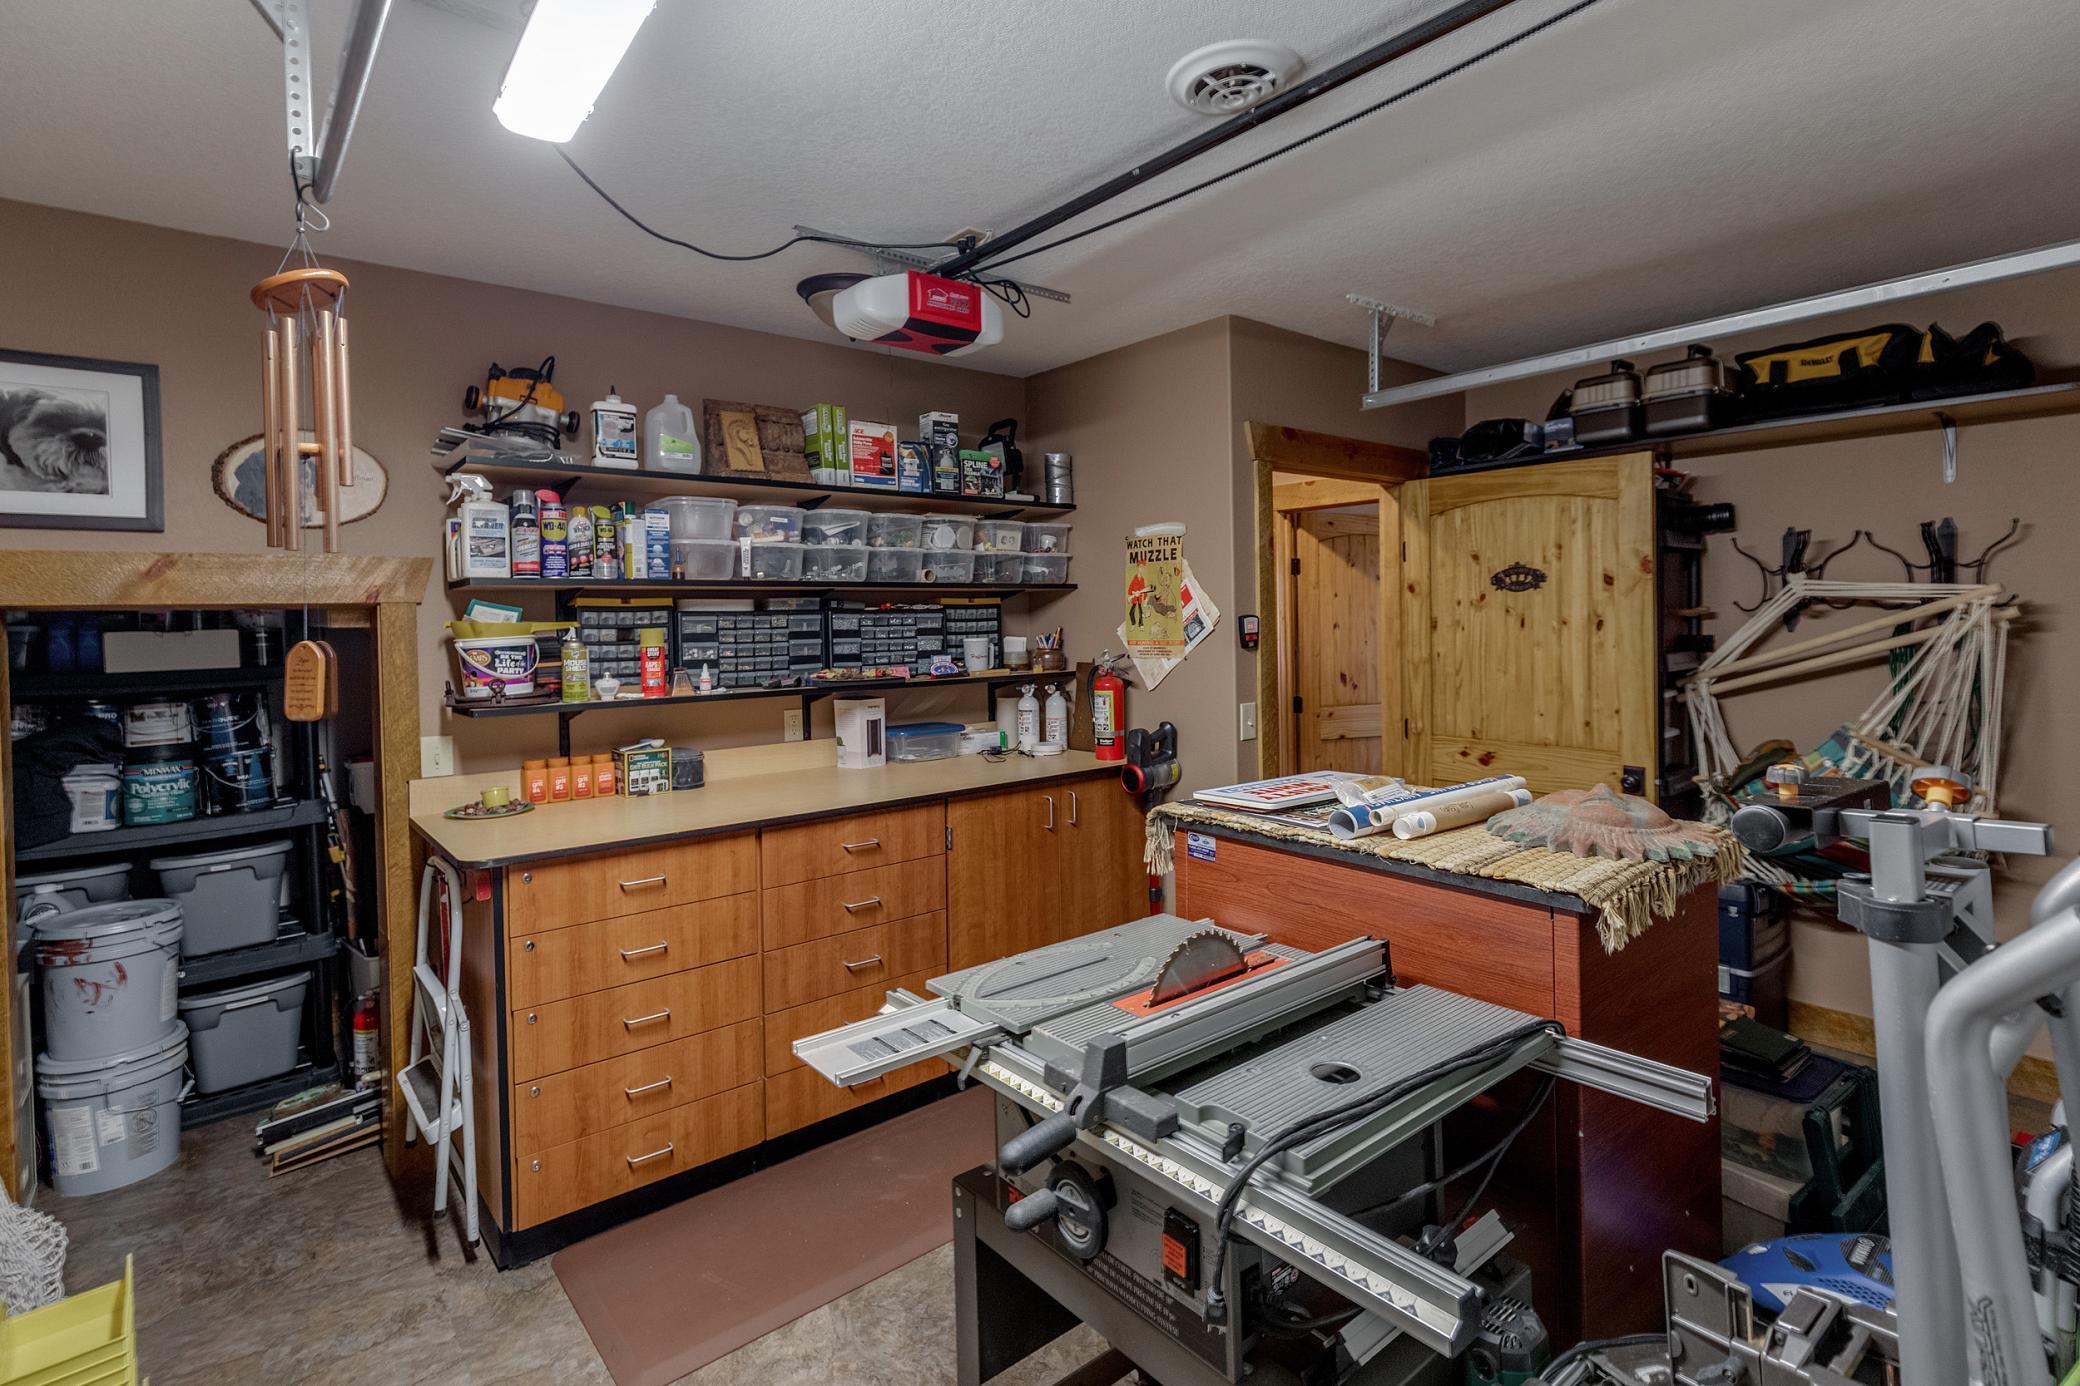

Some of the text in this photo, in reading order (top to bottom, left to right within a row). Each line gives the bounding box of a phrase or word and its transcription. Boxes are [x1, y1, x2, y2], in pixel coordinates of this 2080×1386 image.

[963, 460, 988, 469] SPLINE
[543, 521, 566, 531] WD-40
[1127, 536, 1182, 549] WATCH THAT
[1130, 548, 1177, 564] MUZZLE
[494, 658, 516, 667] Life
[143, 765, 183, 777] MINWAX
[131, 778, 190, 795] Polycrylic
